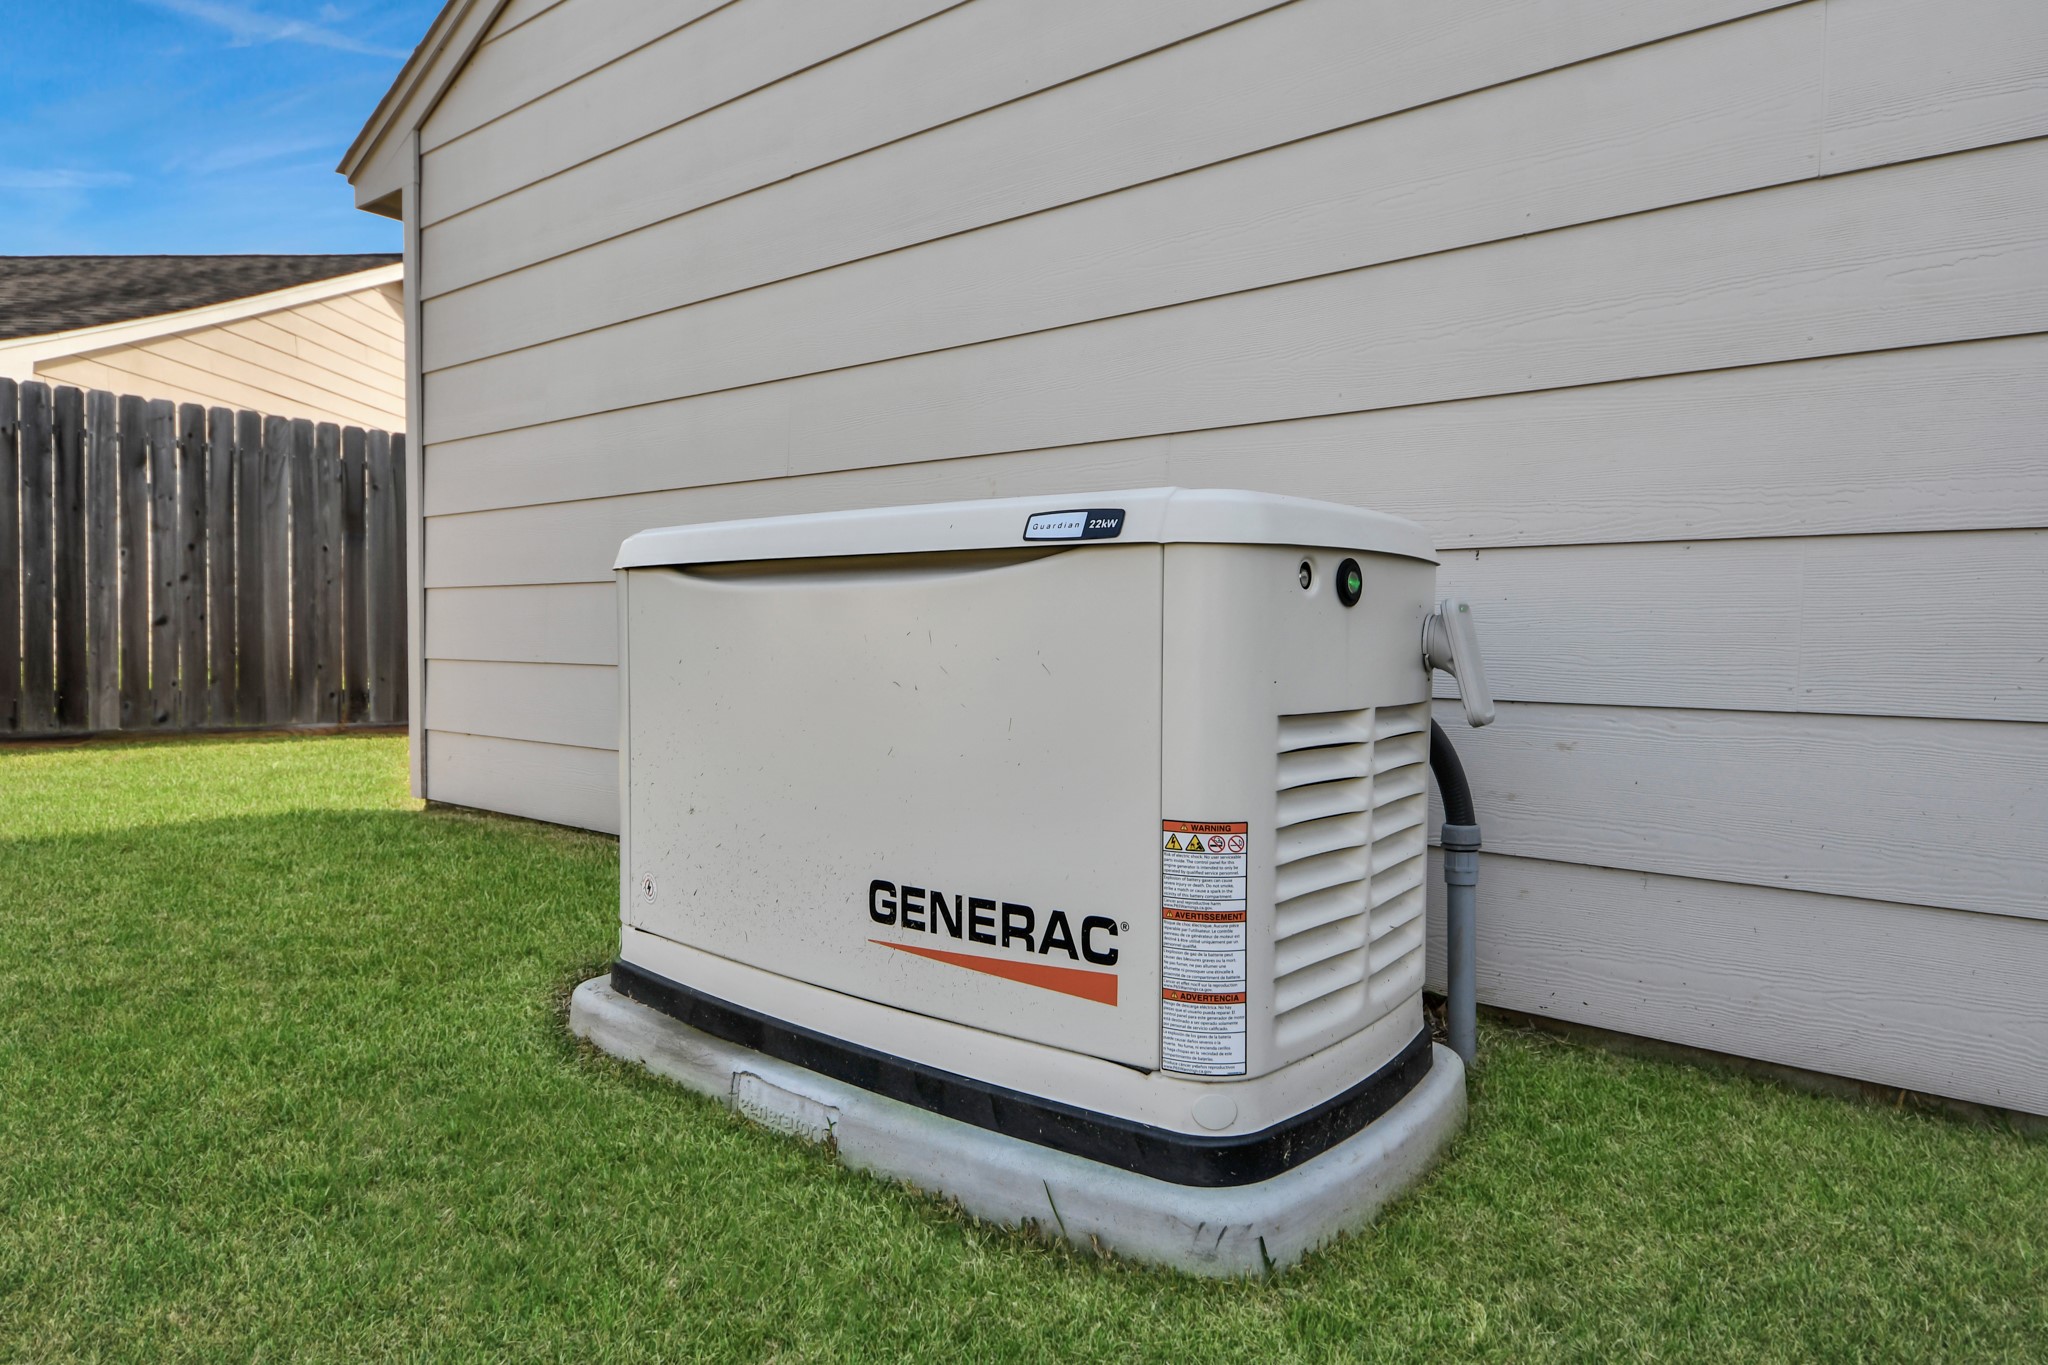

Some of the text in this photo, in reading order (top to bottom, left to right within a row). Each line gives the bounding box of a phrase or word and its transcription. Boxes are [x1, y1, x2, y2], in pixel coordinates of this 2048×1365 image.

[1032, 518, 1118, 531] Guardian 22kW
[1191, 824, 1231, 832] WARNING
[1175, 912, 1243, 921] AVERTISSEMENT
[1180, 993, 1239, 1002] ADVERTENCIA
